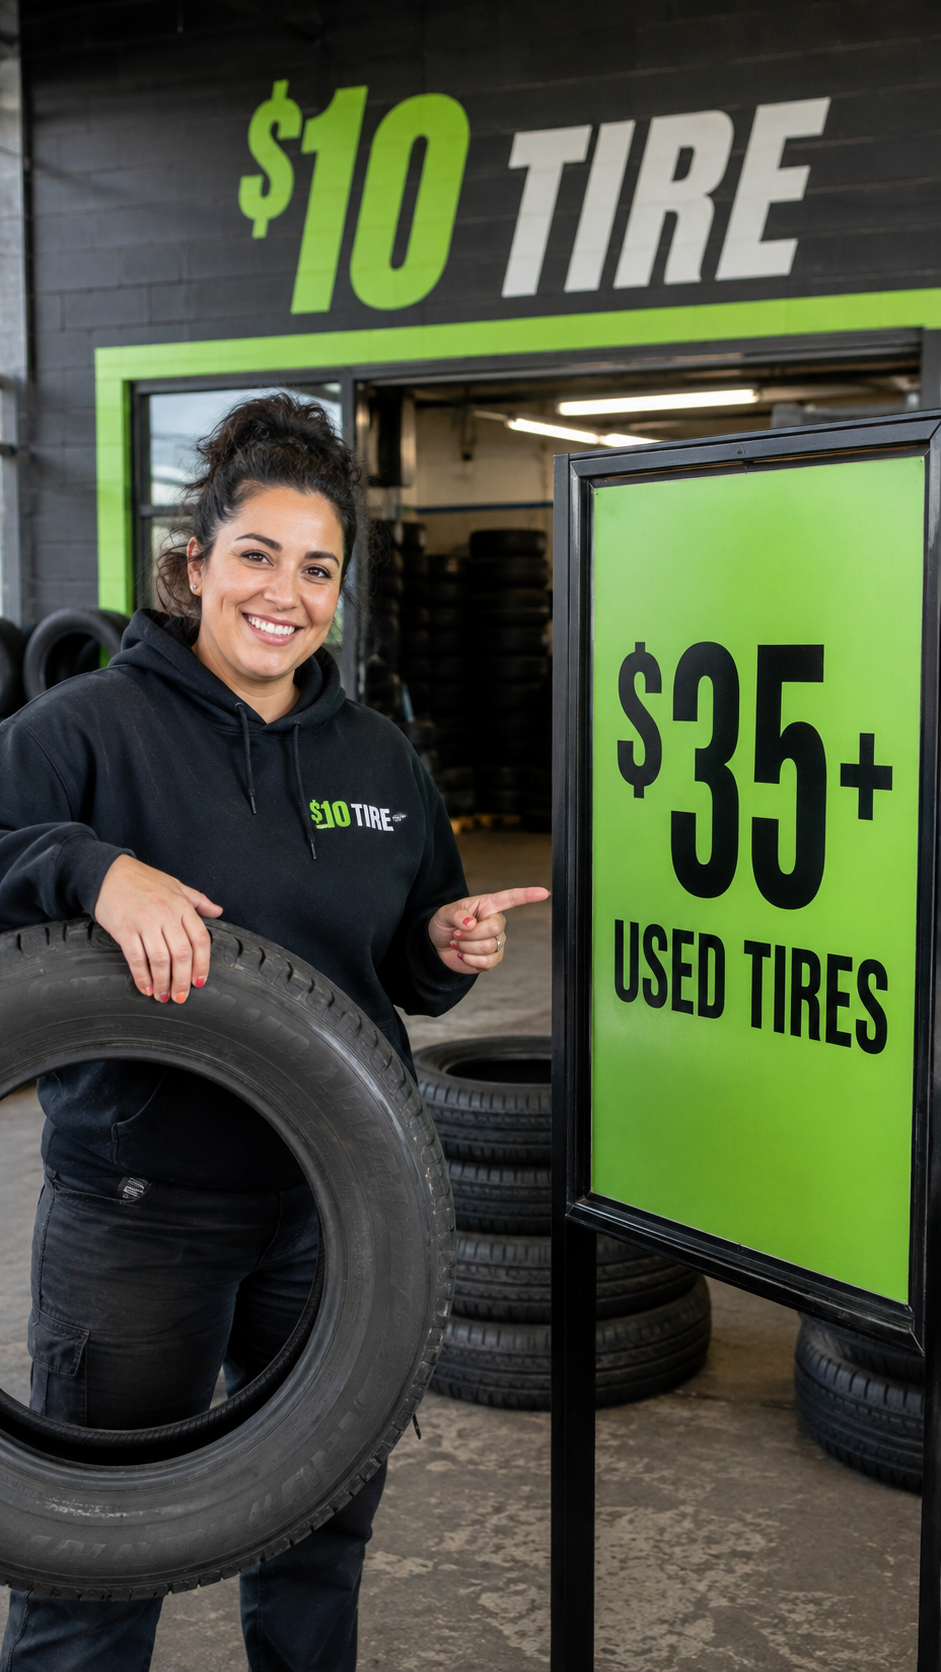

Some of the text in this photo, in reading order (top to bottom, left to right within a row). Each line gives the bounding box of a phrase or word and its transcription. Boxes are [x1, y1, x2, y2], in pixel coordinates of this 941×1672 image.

[239, 79, 831, 314] $10 TIRE
[309, 799, 394, 832] $10 TIRE
[617, 641, 893, 910] $35+
[614, 919, 889, 1055] USED TIRES
